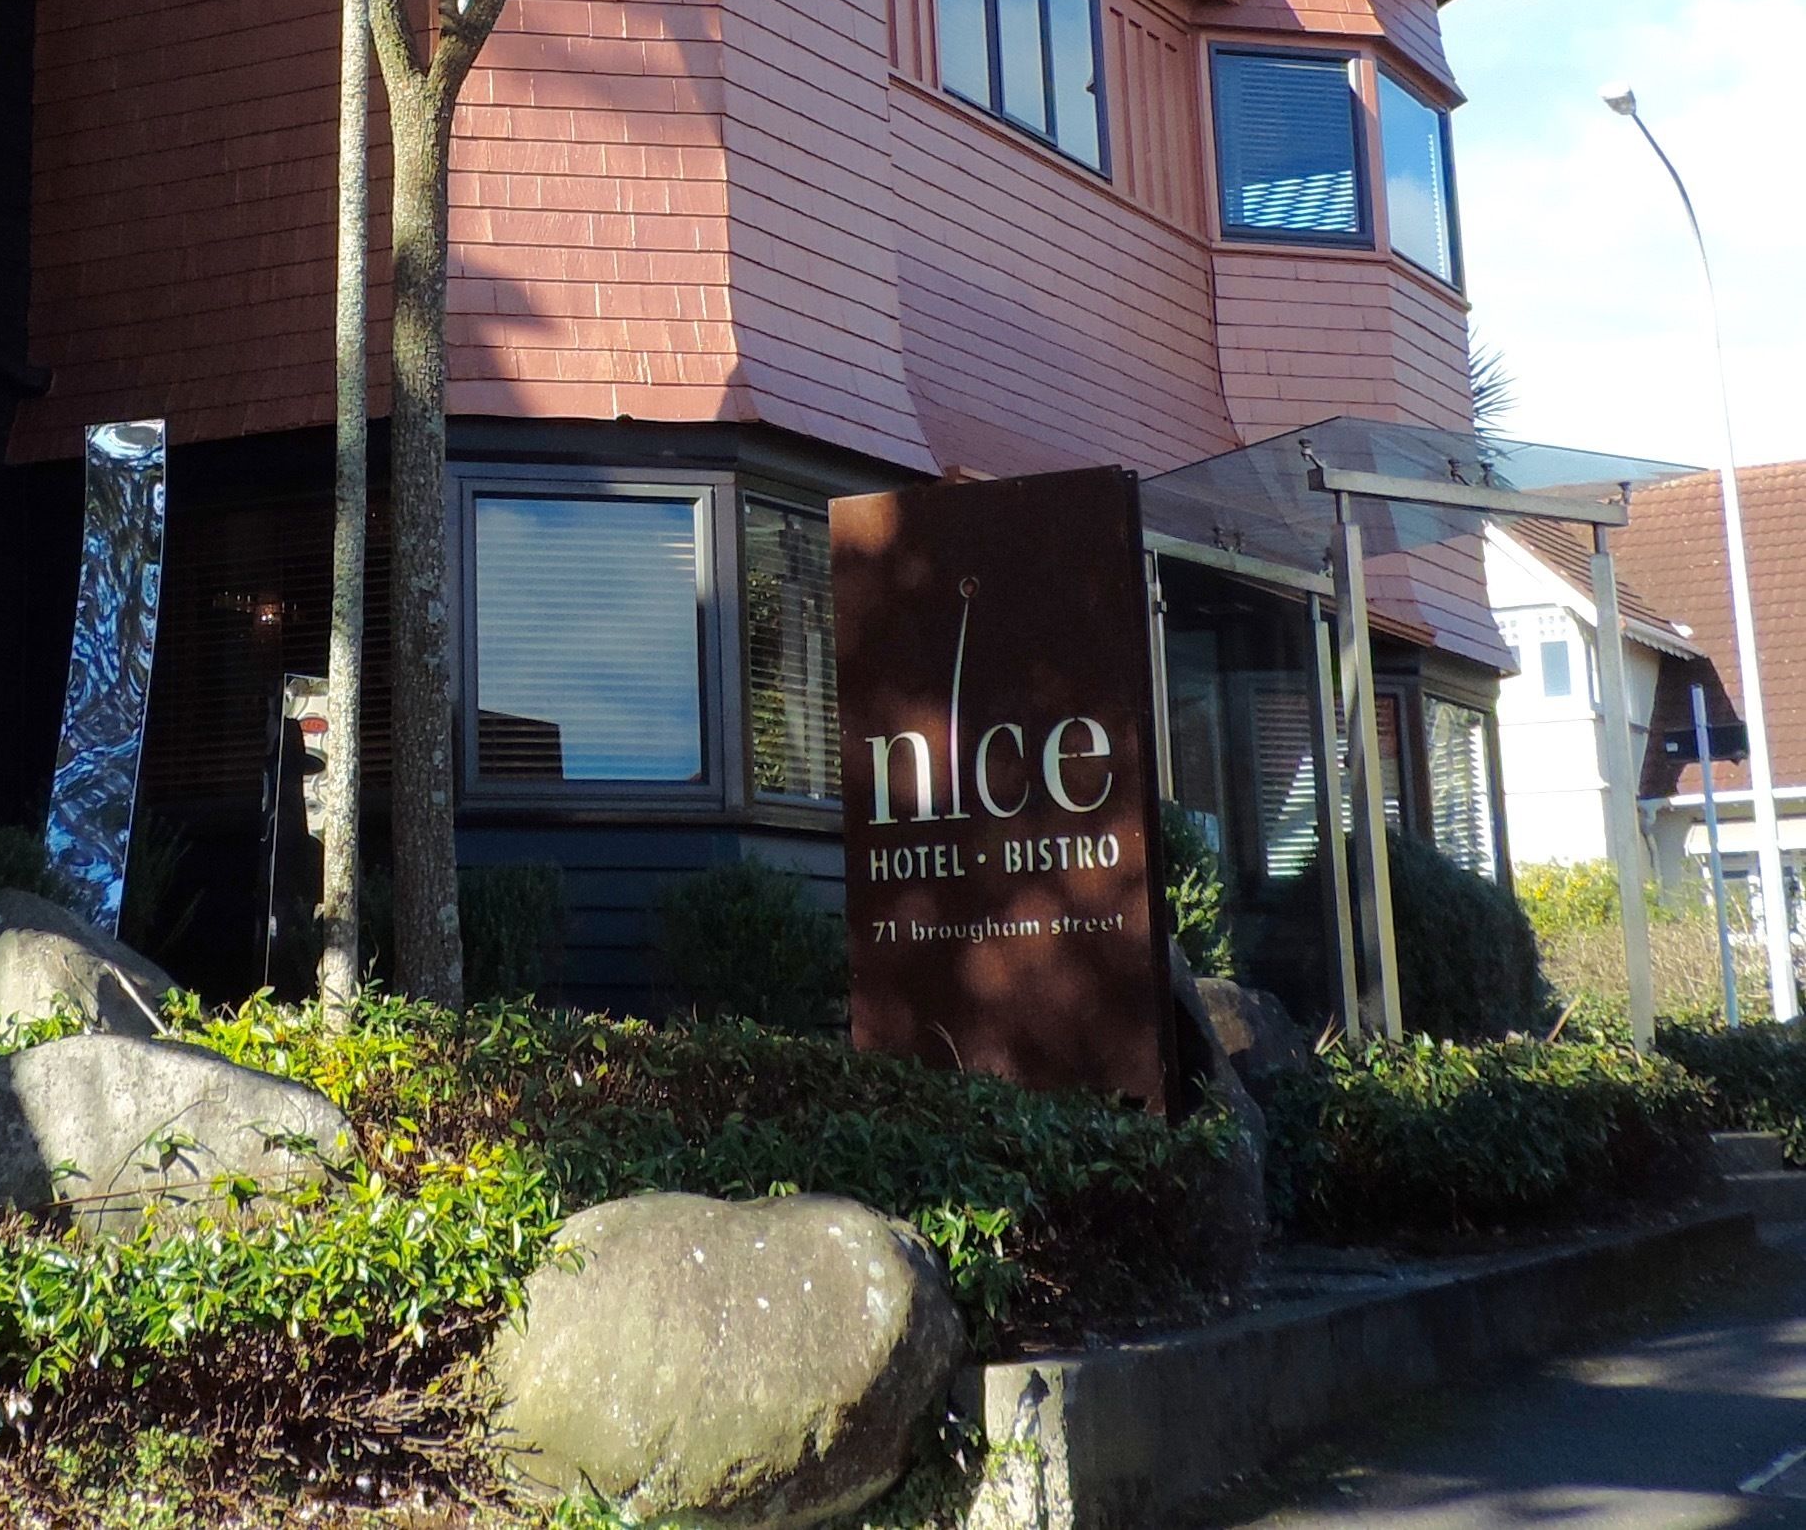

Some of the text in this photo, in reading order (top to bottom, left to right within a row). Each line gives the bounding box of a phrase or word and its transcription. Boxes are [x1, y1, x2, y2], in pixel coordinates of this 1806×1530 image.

[865, 576, 1113, 825] nice
[870, 833, 1120, 881] HOTEL BISTRO
[872, 913, 1124, 943] 71 brougham street
